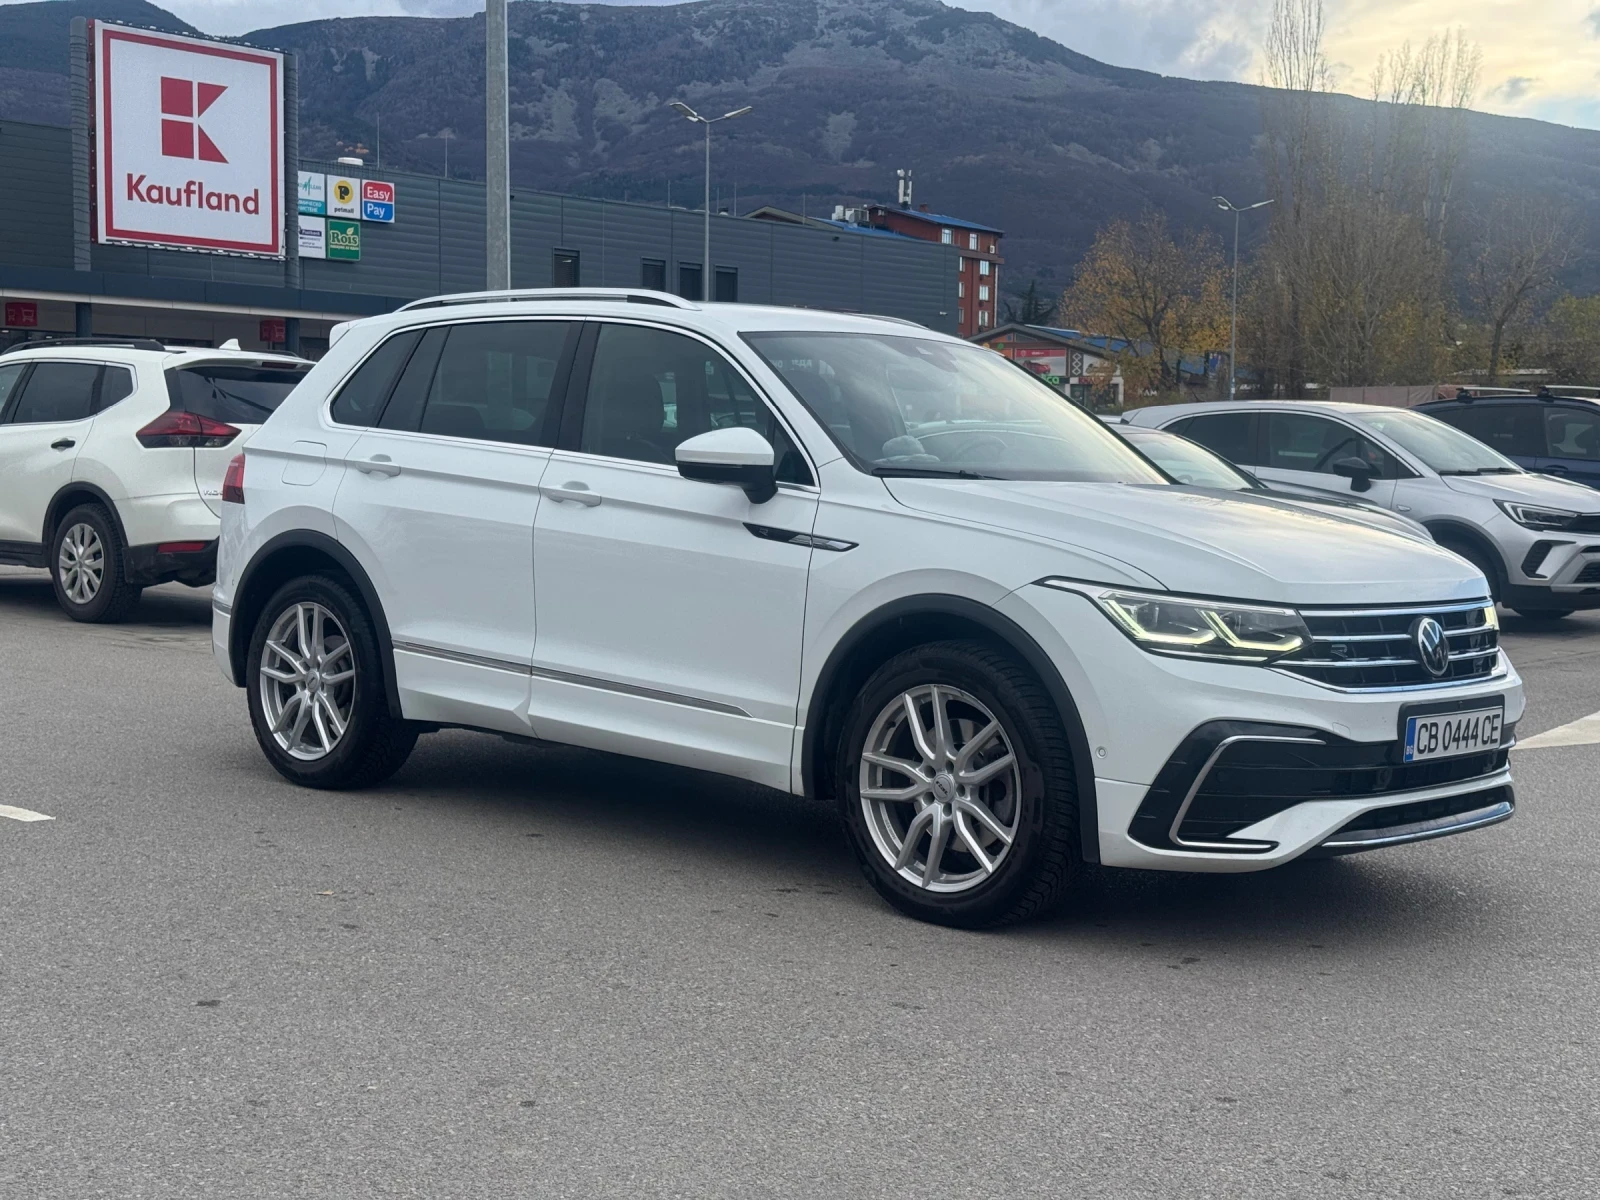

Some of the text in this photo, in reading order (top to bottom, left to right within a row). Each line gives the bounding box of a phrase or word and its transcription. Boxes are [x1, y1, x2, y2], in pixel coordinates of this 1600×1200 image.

[126, 173, 260, 215] Kaufland
[367, 186, 391, 201] Easy
[367, 203, 385, 218] Pay
[330, 230, 358, 245] Rois
[1417, 713, 1501, 754] CB 0444 CE
